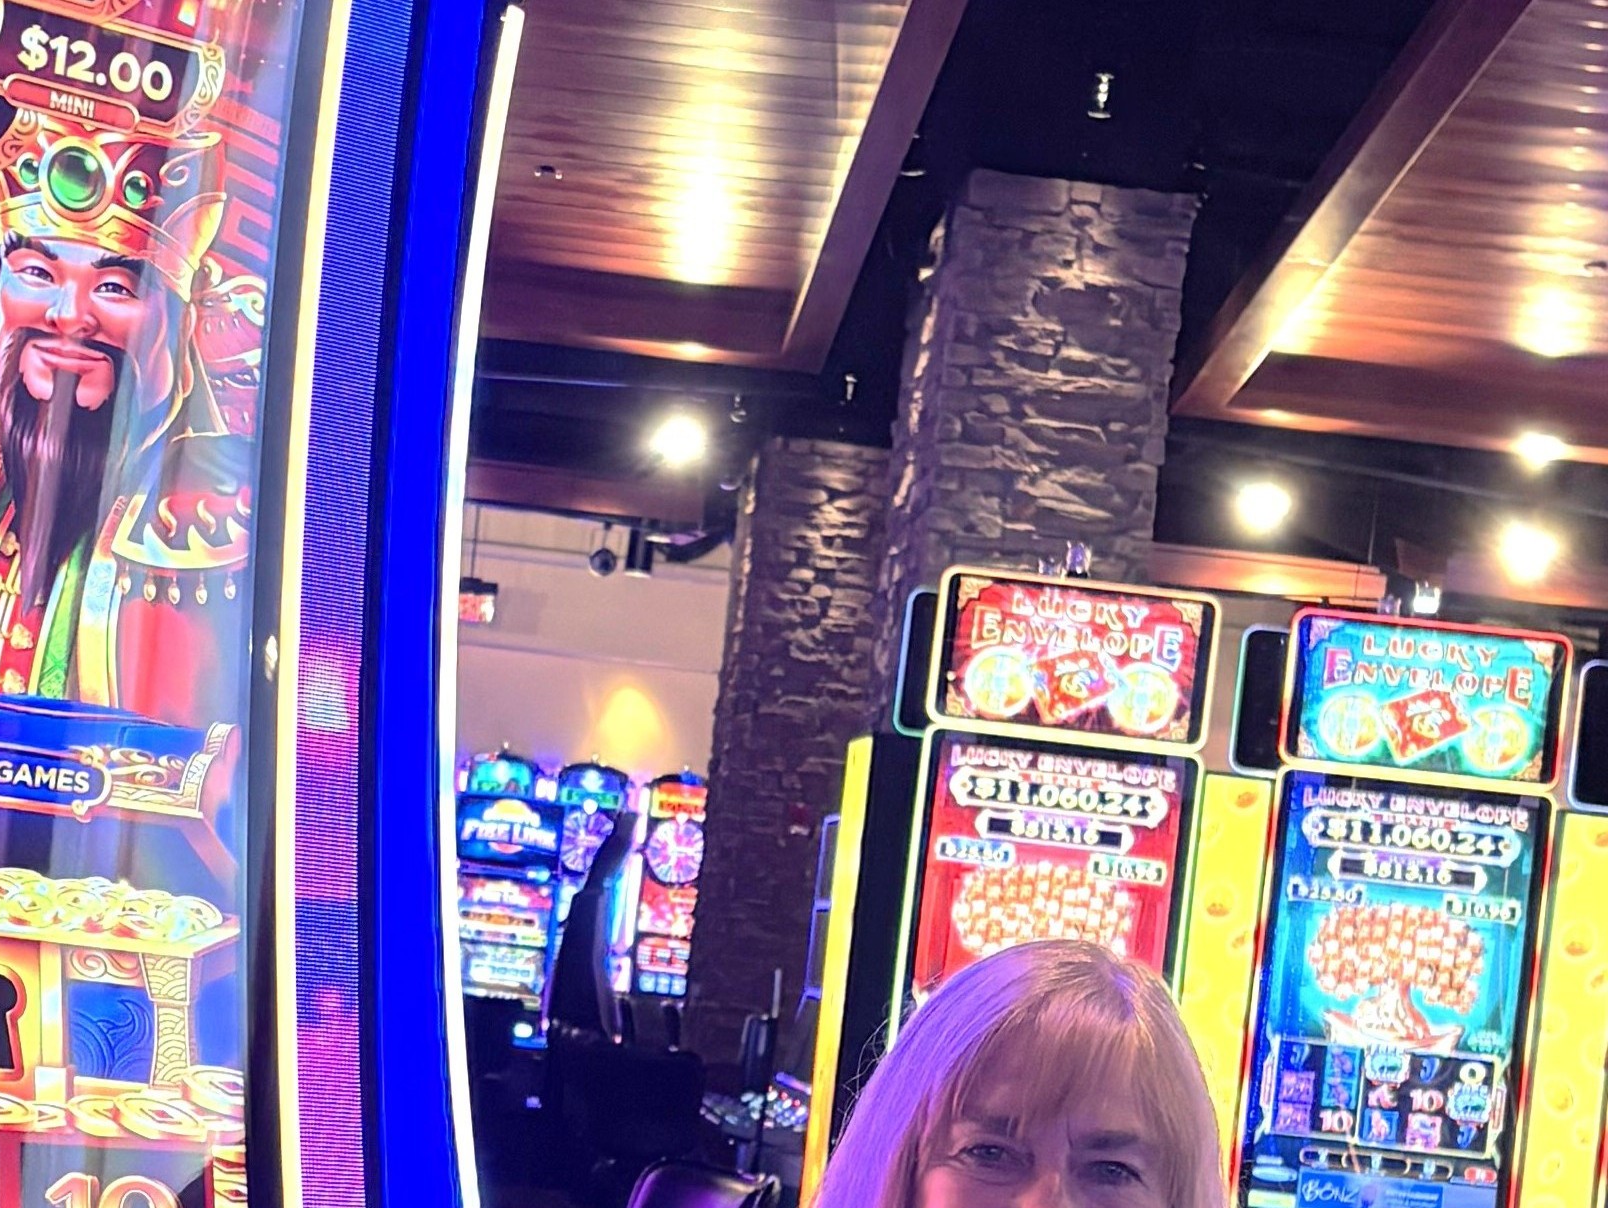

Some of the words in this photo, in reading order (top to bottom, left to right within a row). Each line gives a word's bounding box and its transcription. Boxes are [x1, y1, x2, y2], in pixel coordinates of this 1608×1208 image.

[18, 25, 172, 100] $12.00
[50, 93, 94, 118] MINI
[1012, 590, 1148, 631] LUCKY
[972, 604, 1183, 673] ENVELOPE
[1363, 634, 1499, 671] LUCKY
[1323, 646, 1533, 708] ENVELOPE
[951, 744, 1033, 771] LUCKY
[1038, 752, 1177, 792] ENVELOPE
[975, 778, 1143, 817] $11,060.24
[1303, 786, 1384, 812] LUCKY
[1390, 792, 1528, 832] ENVELOPE
[1327, 818, 1495, 856] $11,060.24
